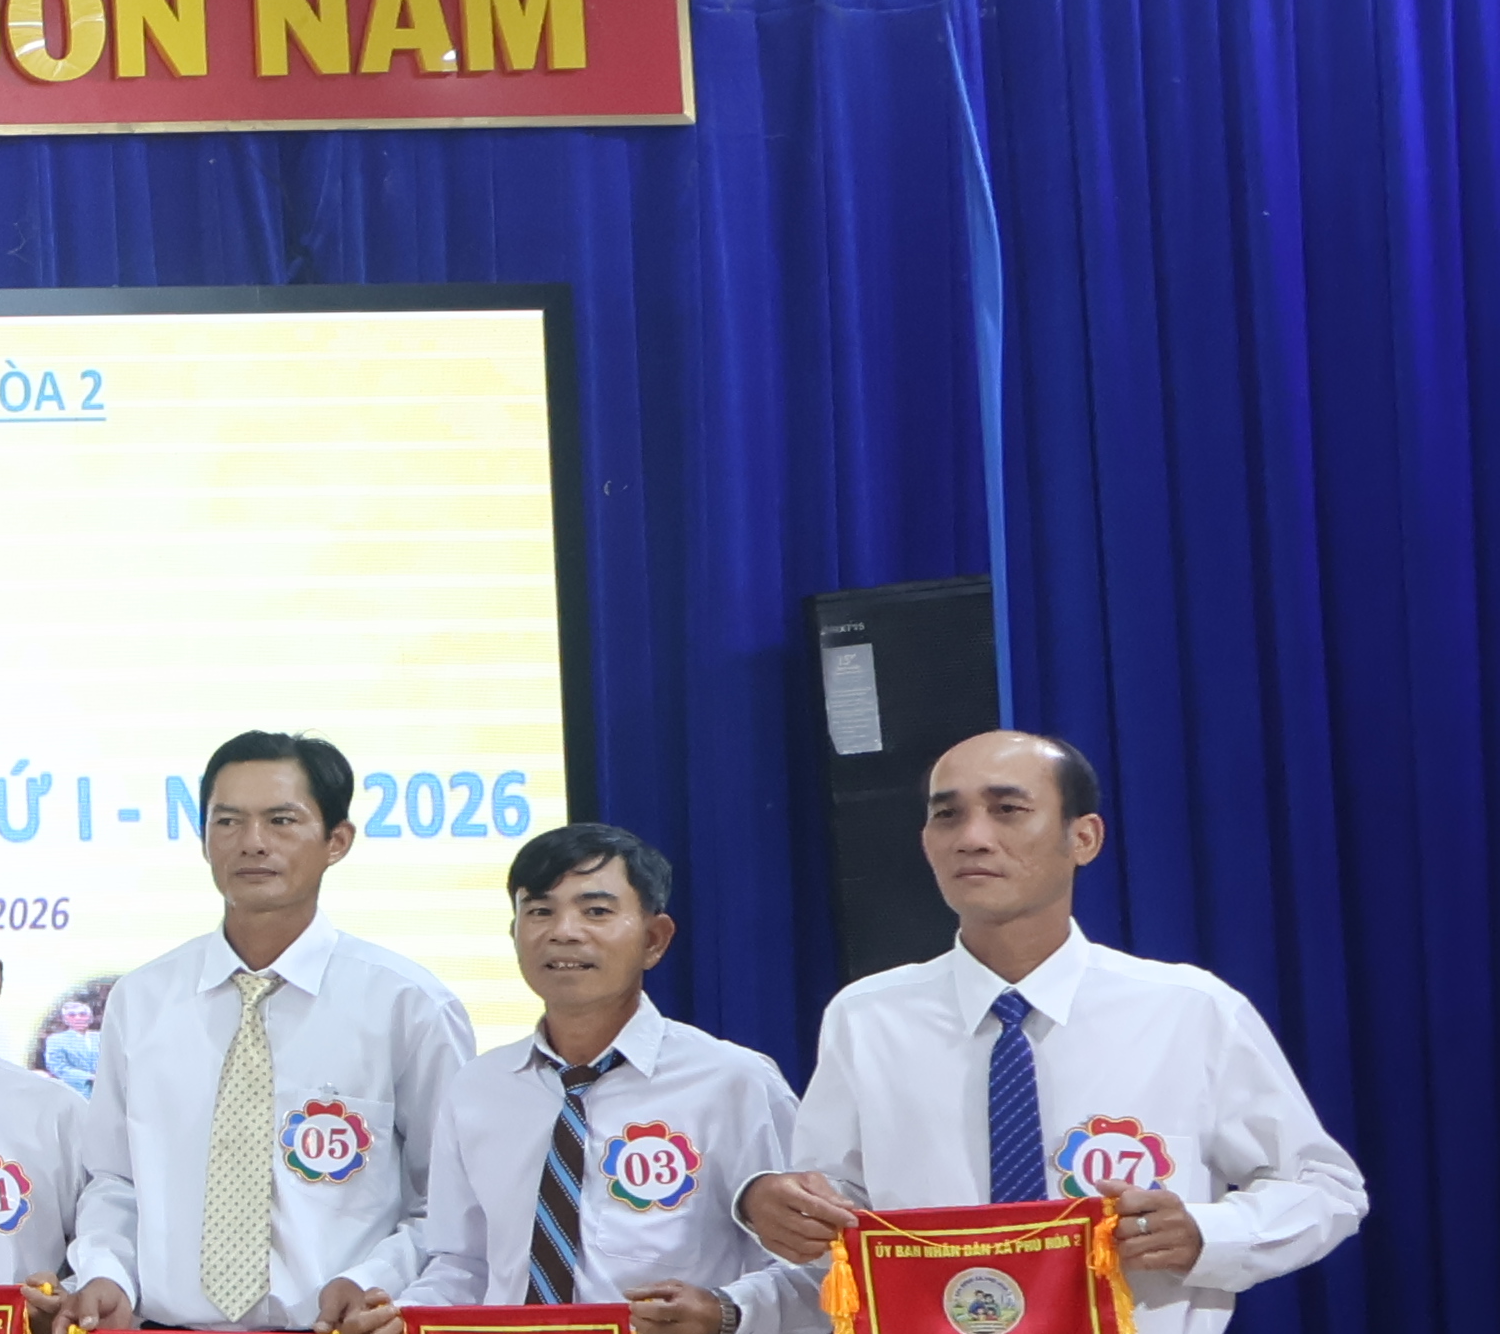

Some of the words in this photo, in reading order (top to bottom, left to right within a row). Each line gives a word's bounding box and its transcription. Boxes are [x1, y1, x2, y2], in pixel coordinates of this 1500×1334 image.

[79, 369, 104, 411] 2
[77, 776, 92, 841] I
[362, 771, 531, 838] 2026
[301, 1127, 350, 1160] 05
[624, 1149, 678, 1186] 03
[1082, 1148, 1145, 1185] 07
